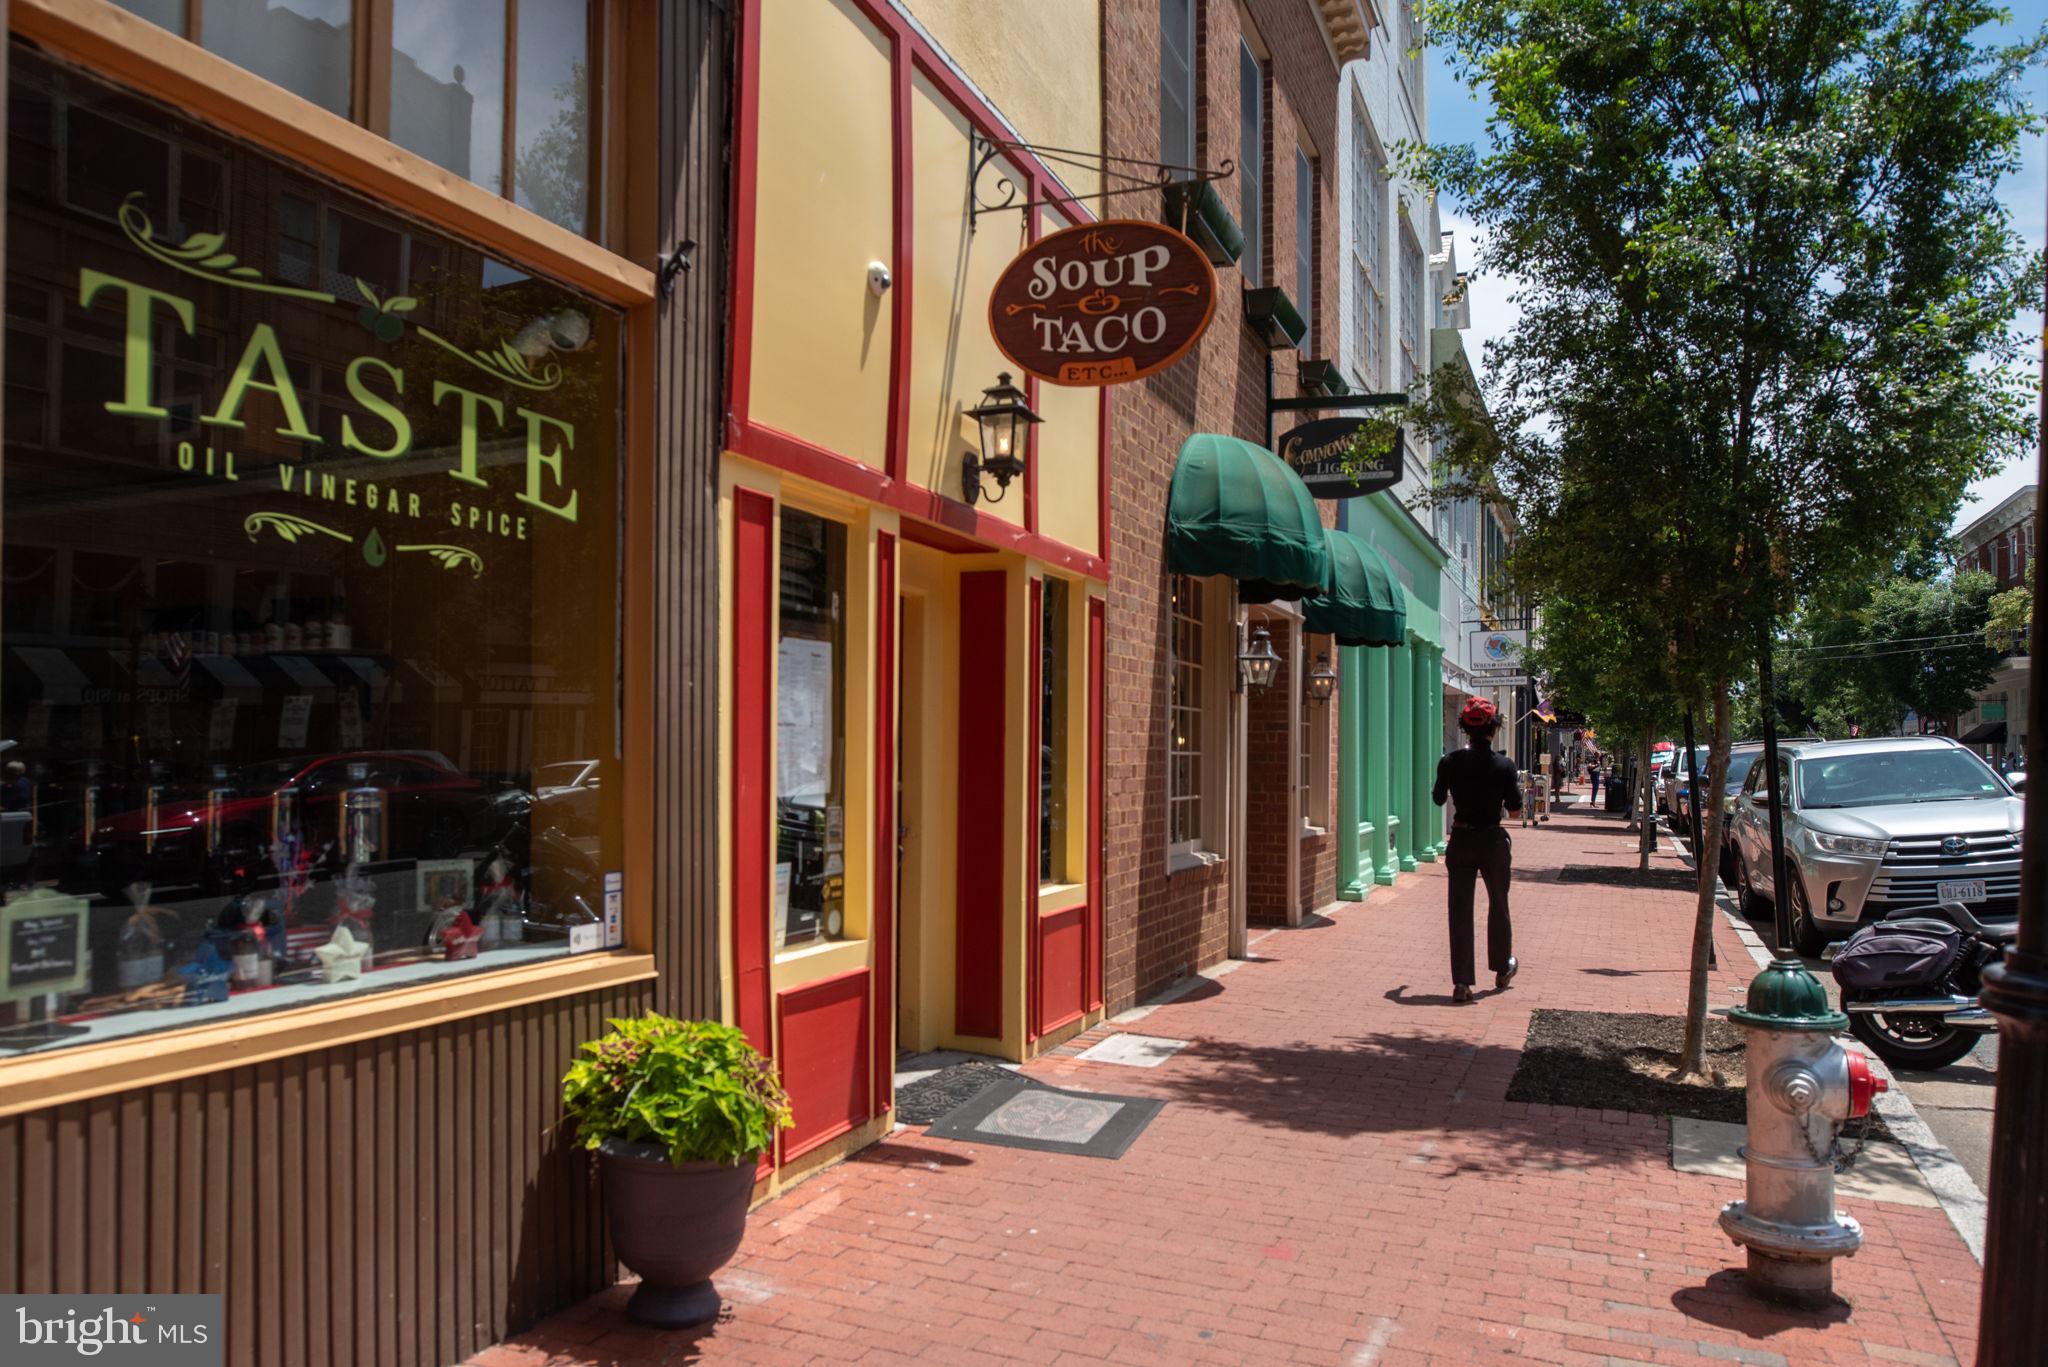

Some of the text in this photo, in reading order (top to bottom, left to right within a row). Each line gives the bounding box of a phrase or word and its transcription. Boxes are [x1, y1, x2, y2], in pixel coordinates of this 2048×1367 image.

[1028, 245, 1170, 300] SOUP
[1033, 306, 1167, 354] TACO
[80, 266, 578, 523] TASTE
[178, 441, 527, 541] OIL VINEGAR SPICE
[1316, 458, 1385, 475] LIGING
